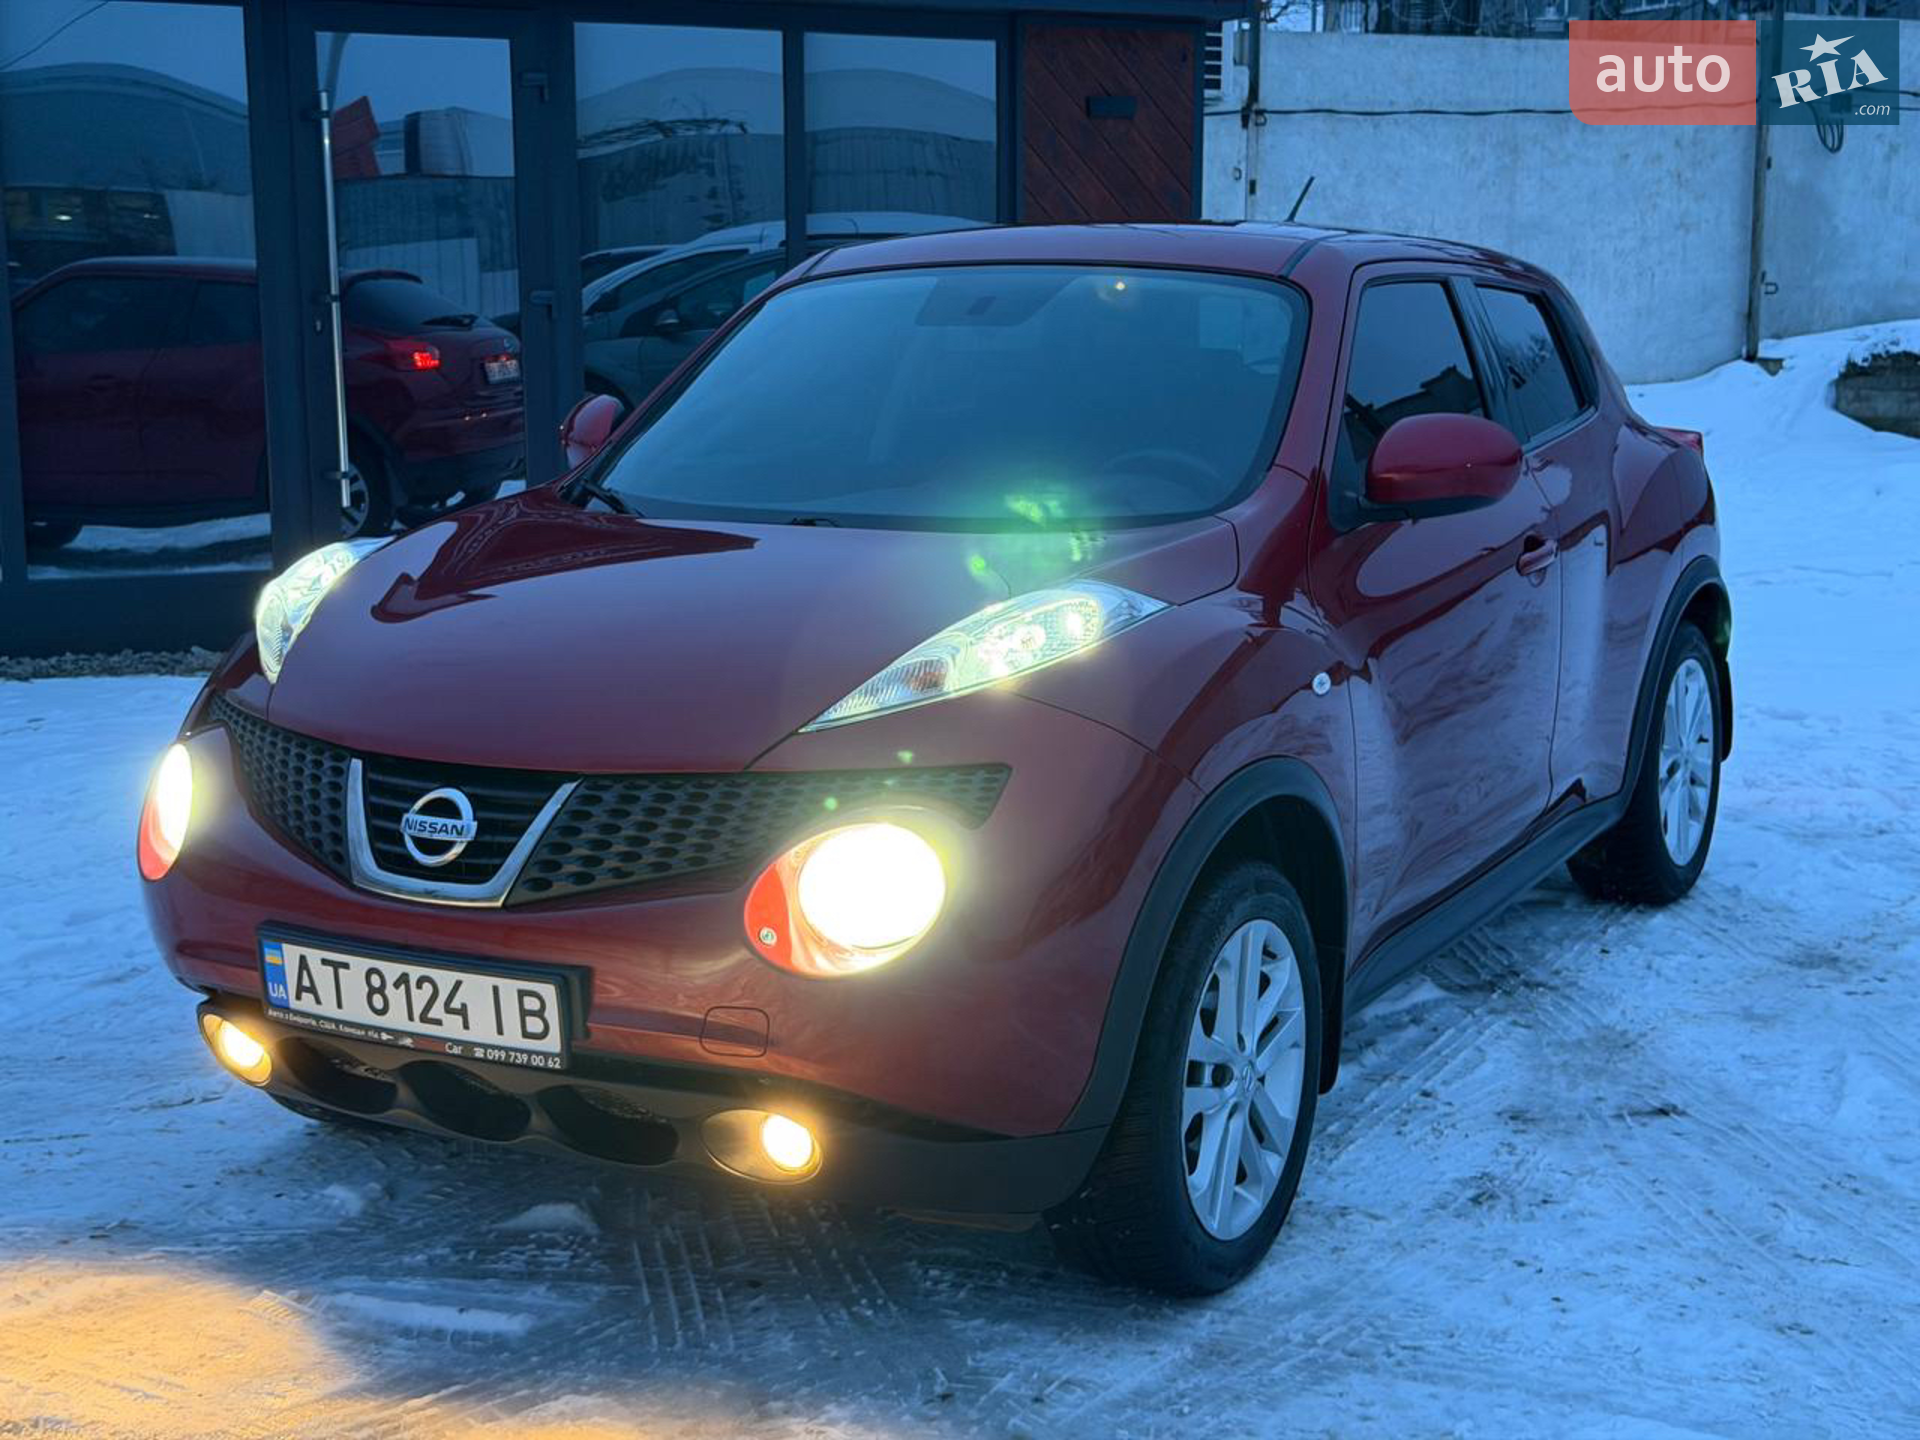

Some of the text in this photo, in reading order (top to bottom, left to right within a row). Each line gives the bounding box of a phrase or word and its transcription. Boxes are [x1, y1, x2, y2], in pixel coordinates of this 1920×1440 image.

[404, 817, 465, 836] NISSAN
[268, 982, 288, 1000] UA
[295, 954, 550, 1041] AT 8124 IB
[444, 1041, 462, 1055] Car
[486, 1049, 562, 1069] 099 739 00 62
